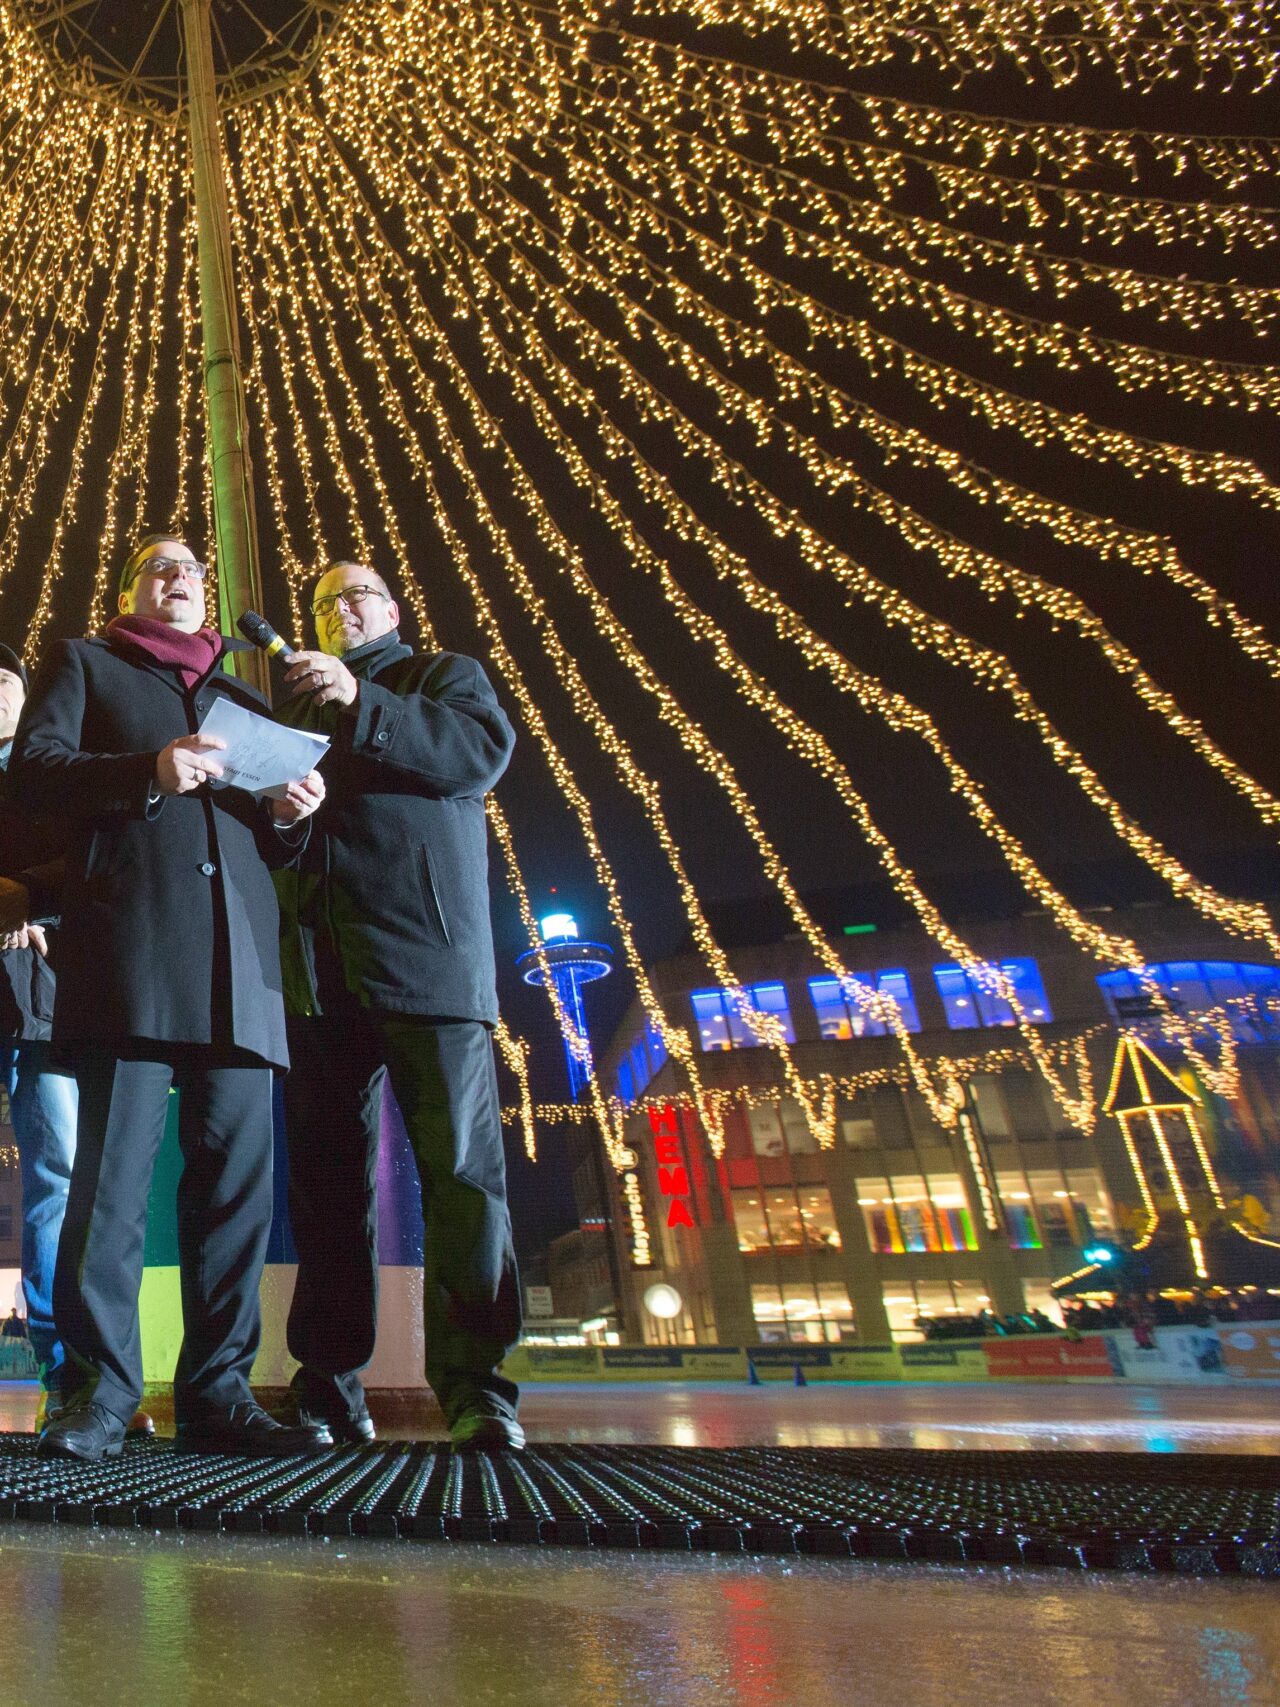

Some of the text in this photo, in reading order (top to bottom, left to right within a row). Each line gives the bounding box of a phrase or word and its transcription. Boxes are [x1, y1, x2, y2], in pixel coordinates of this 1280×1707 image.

[241, 772, 261, 781] ESSEN
[648, 1104, 694, 1228] HEMA
[624, 1173, 651, 1265] Mayersche
